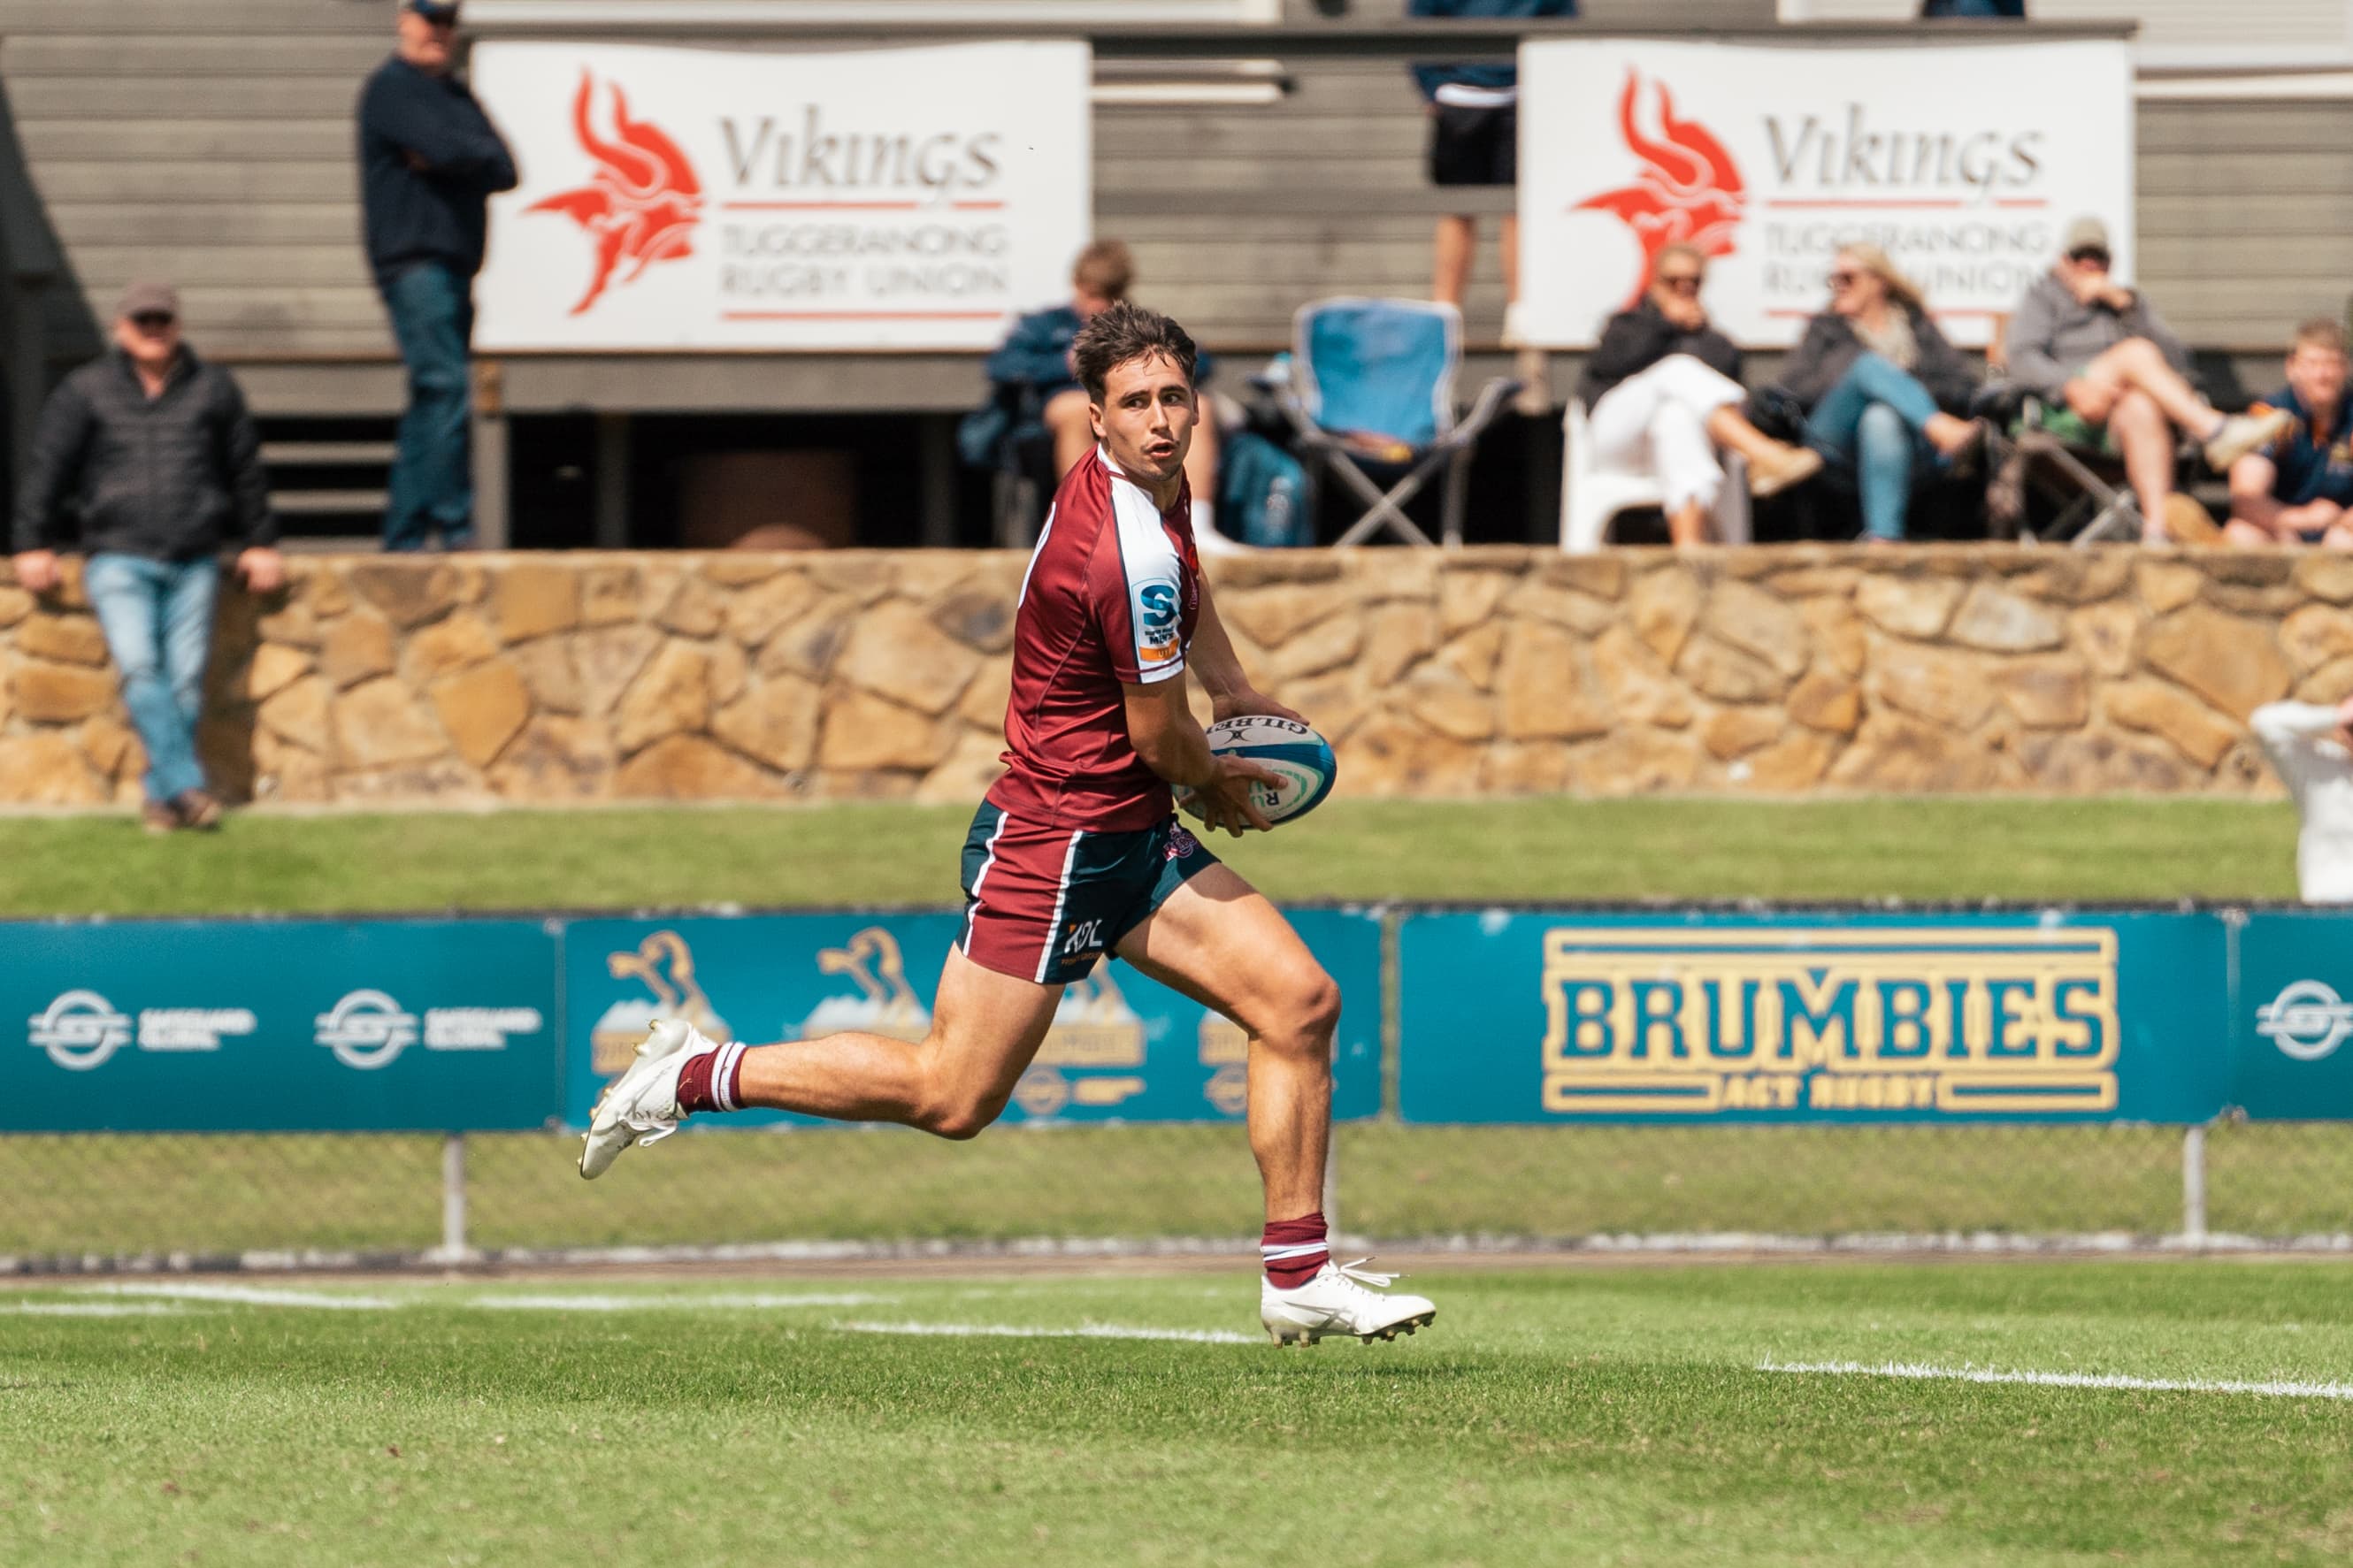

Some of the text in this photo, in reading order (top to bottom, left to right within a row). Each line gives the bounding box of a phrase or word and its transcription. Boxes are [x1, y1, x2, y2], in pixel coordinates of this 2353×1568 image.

[719, 103, 1004, 203] Vikings
[1762, 101, 2045, 203] Vikings
[721, 221, 1011, 256] TUGGERANONG
[721, 263, 1011, 296] RUGBY UNION
[1559, 977, 2105, 1059] BRUMBIES
[1722, 1073, 1938, 1111] ACT RUGBY
